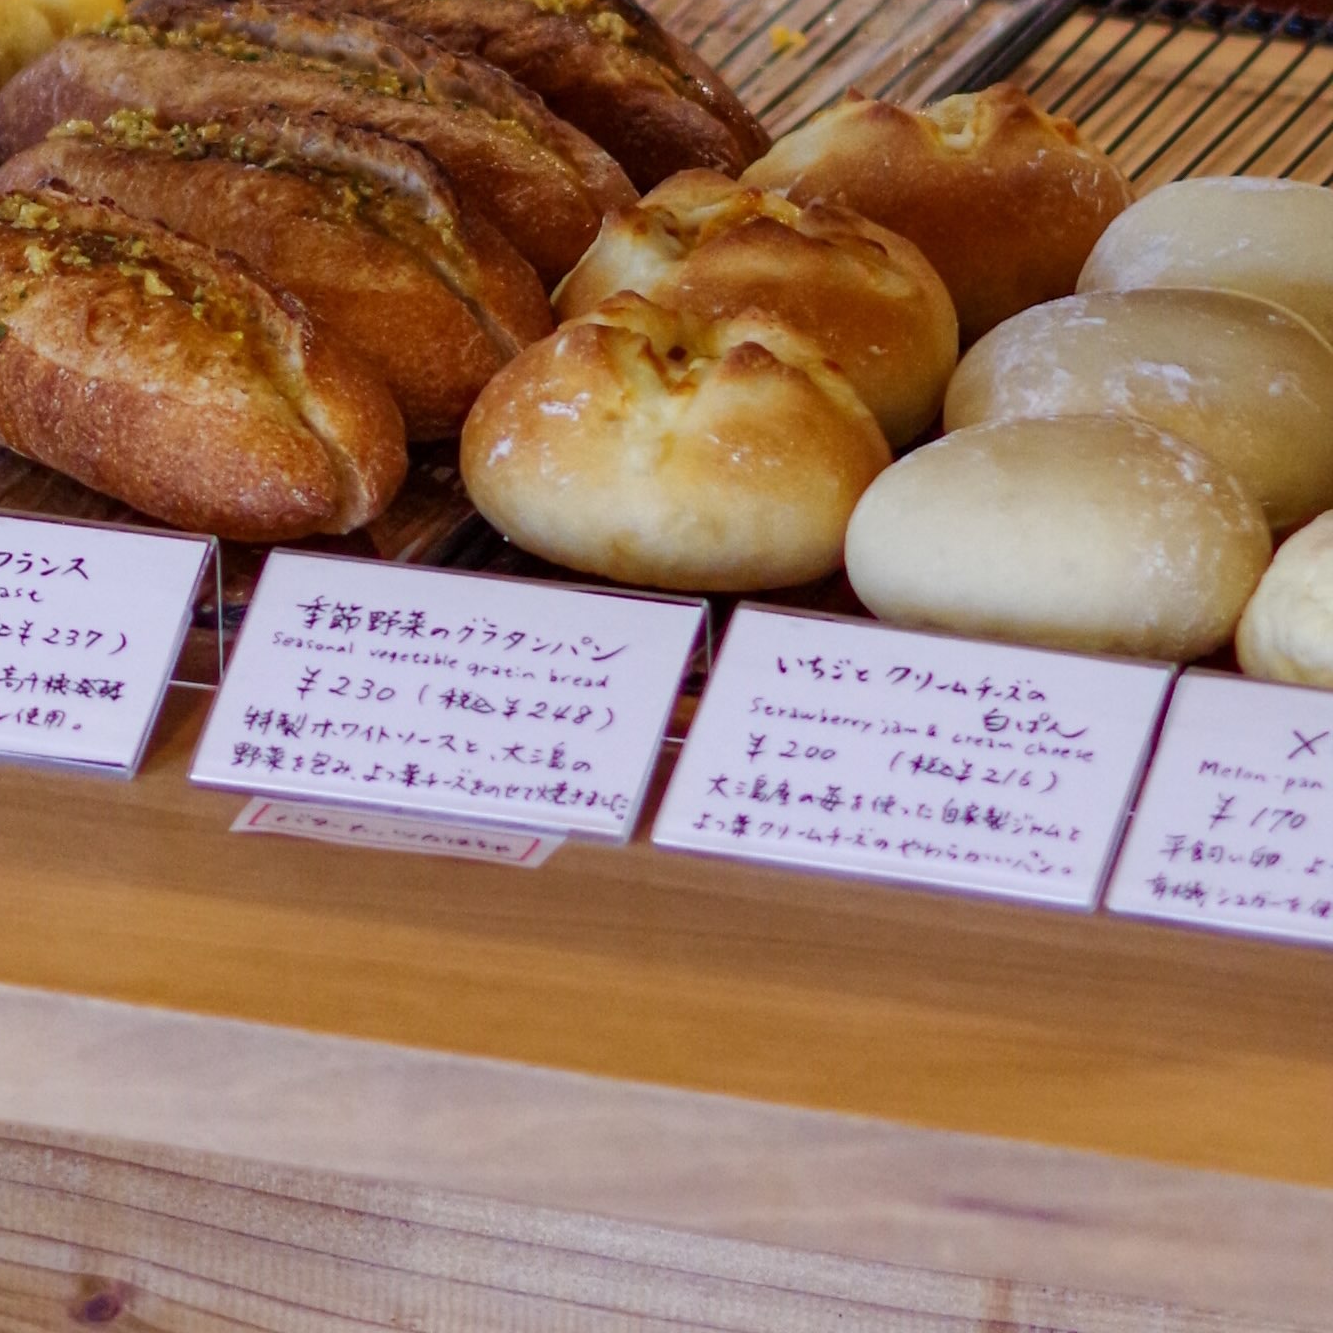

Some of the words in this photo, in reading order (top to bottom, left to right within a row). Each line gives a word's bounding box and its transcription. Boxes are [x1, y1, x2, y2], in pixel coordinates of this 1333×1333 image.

[297, 594, 629, 663] 季節野菜のグラタンパン
[271, 631, 354, 656] Seasonal
[368, 647, 458, 670] vegetable
[549, 668, 609, 688] bread
[776, 654, 1048, 703] いちごとクリームチーズの
